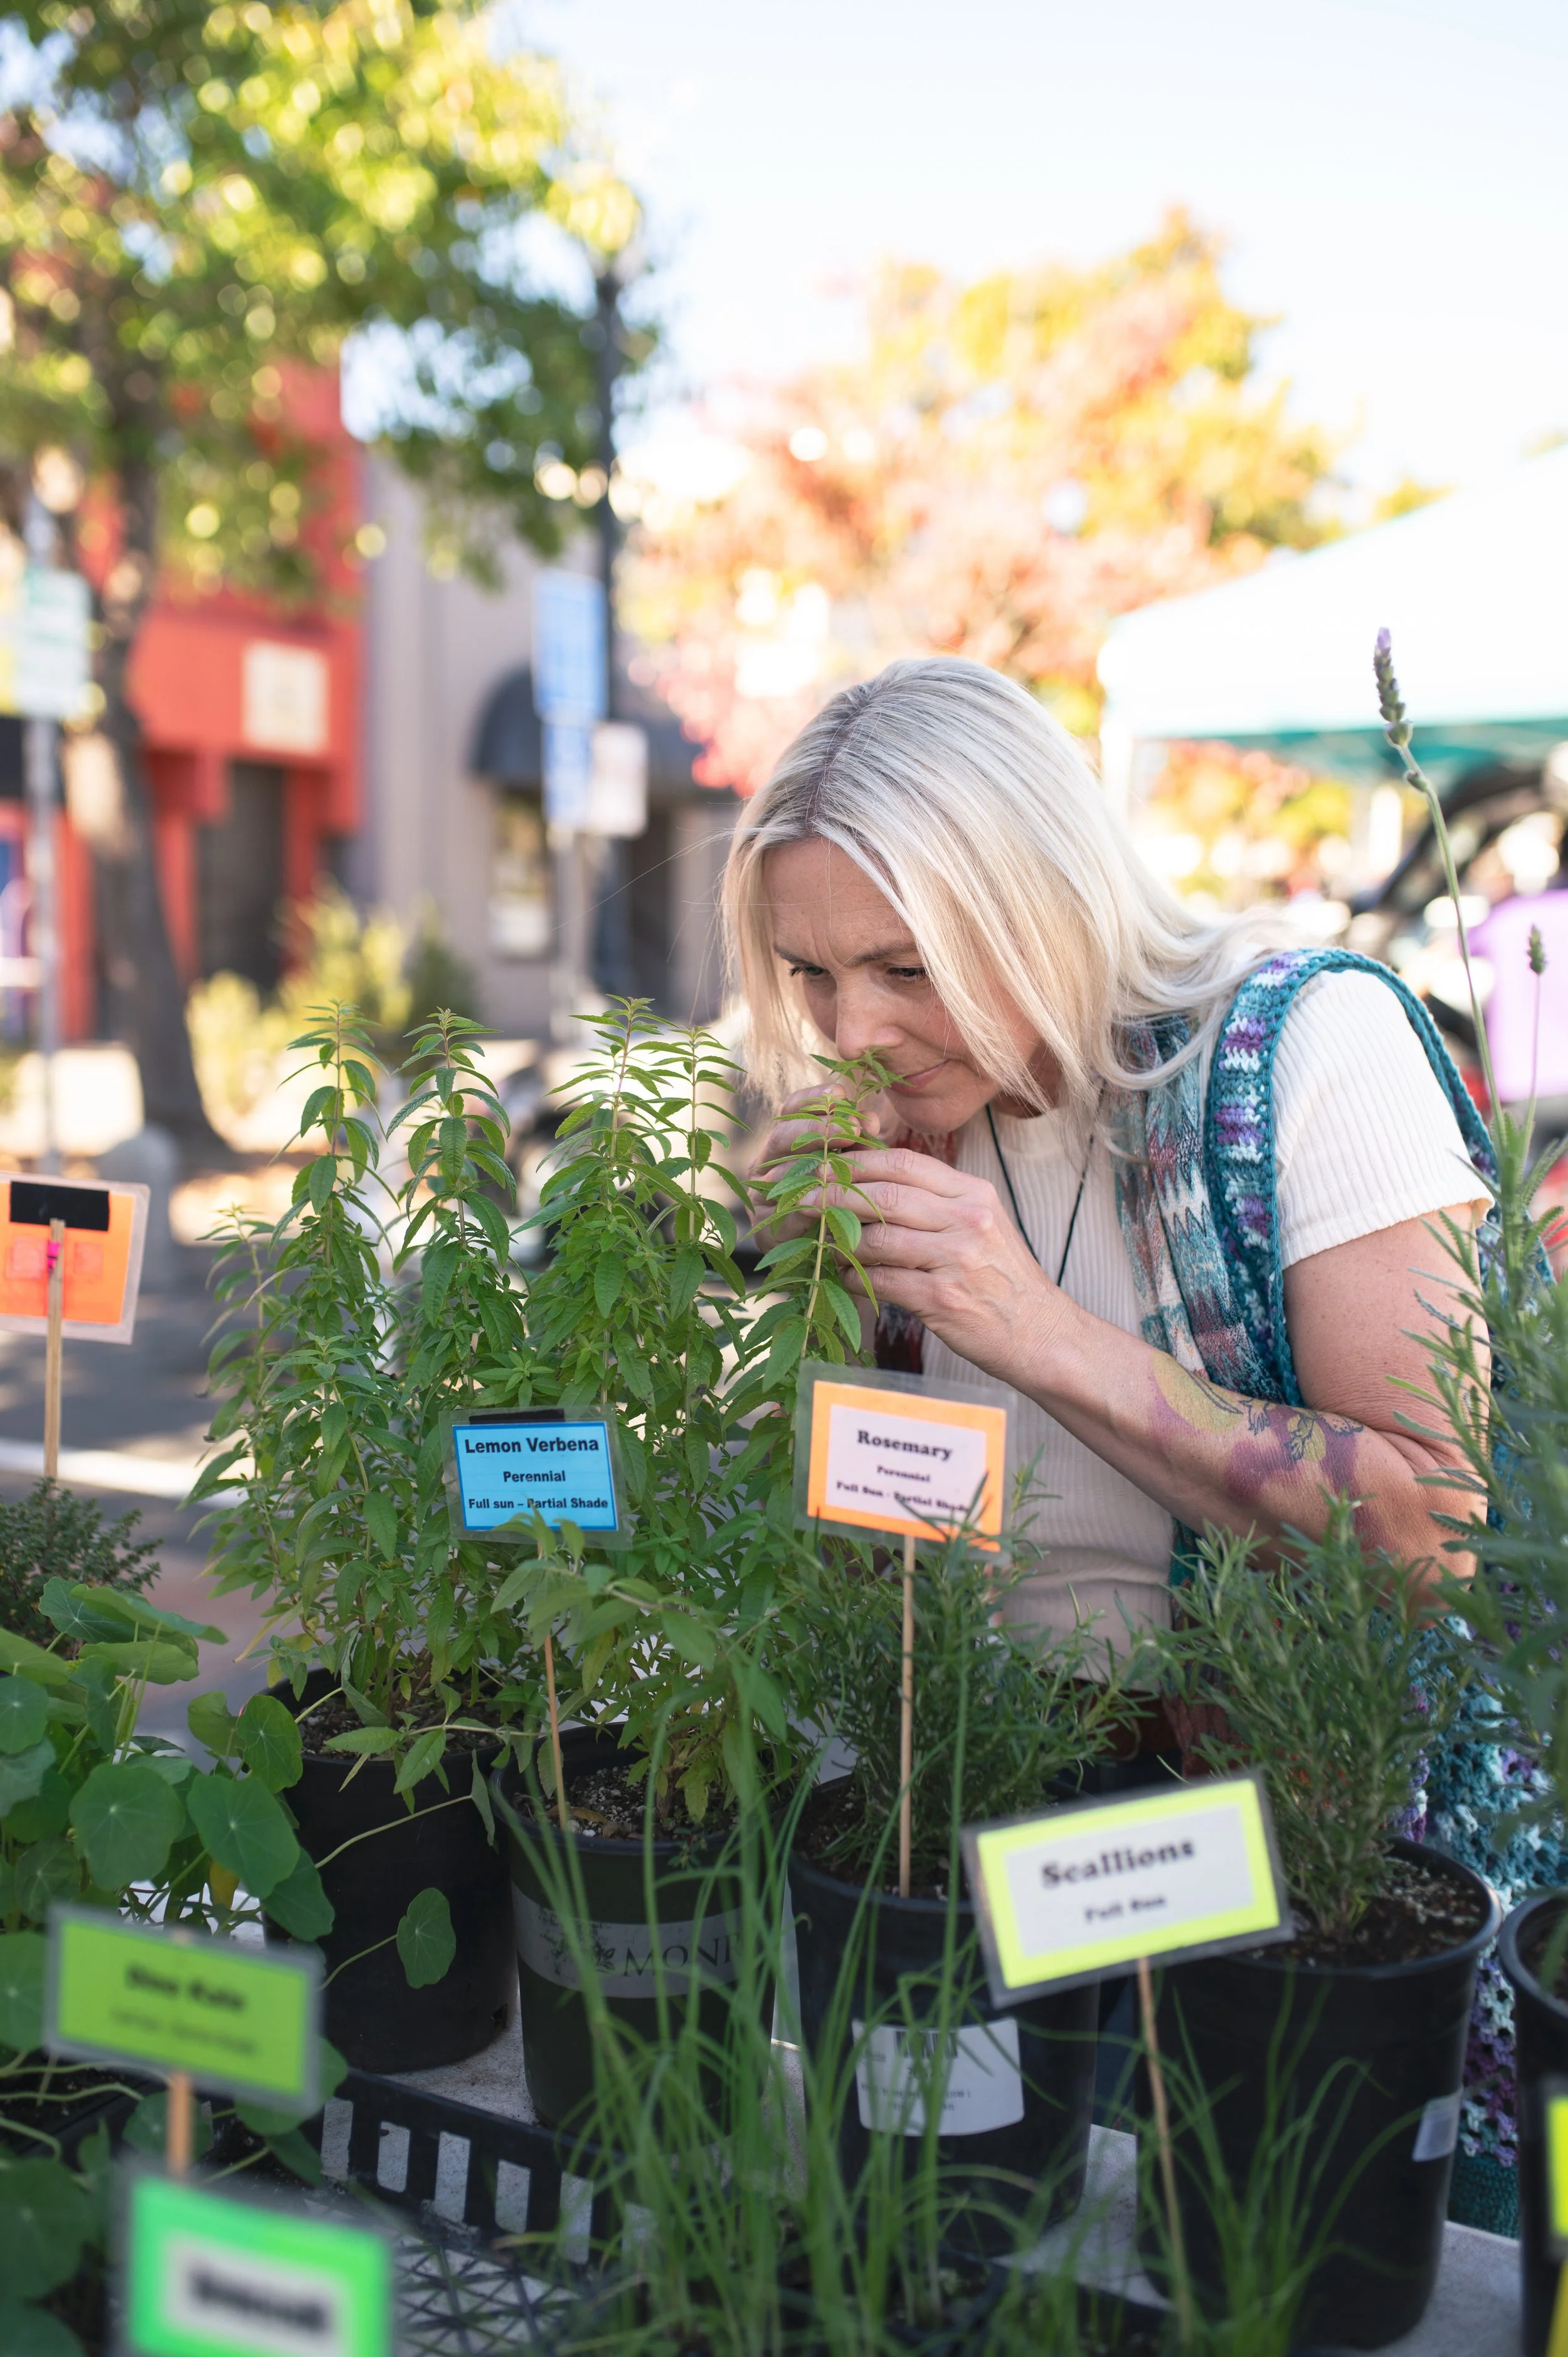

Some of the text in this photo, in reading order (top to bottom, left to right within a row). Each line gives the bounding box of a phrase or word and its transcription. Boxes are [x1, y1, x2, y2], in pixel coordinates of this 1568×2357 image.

[465, 1437, 600, 1454] Lemon Verbena
[857, 1429, 953, 1461] Rosemary
[503, 1471, 566, 1483] Perennial
[876, 1465, 931, 1483] Perennial
[469, 1498, 490, 1509] Full
[493, 1500, 514, 1509] sun
[527, 1498, 567, 1508] Partial
[570, 1498, 608, 1508] Shade
[836, 1481, 859, 1492] Full
[936, 1499, 969, 1513] Shad
[1041, 1839, 1195, 1888] Scallions
